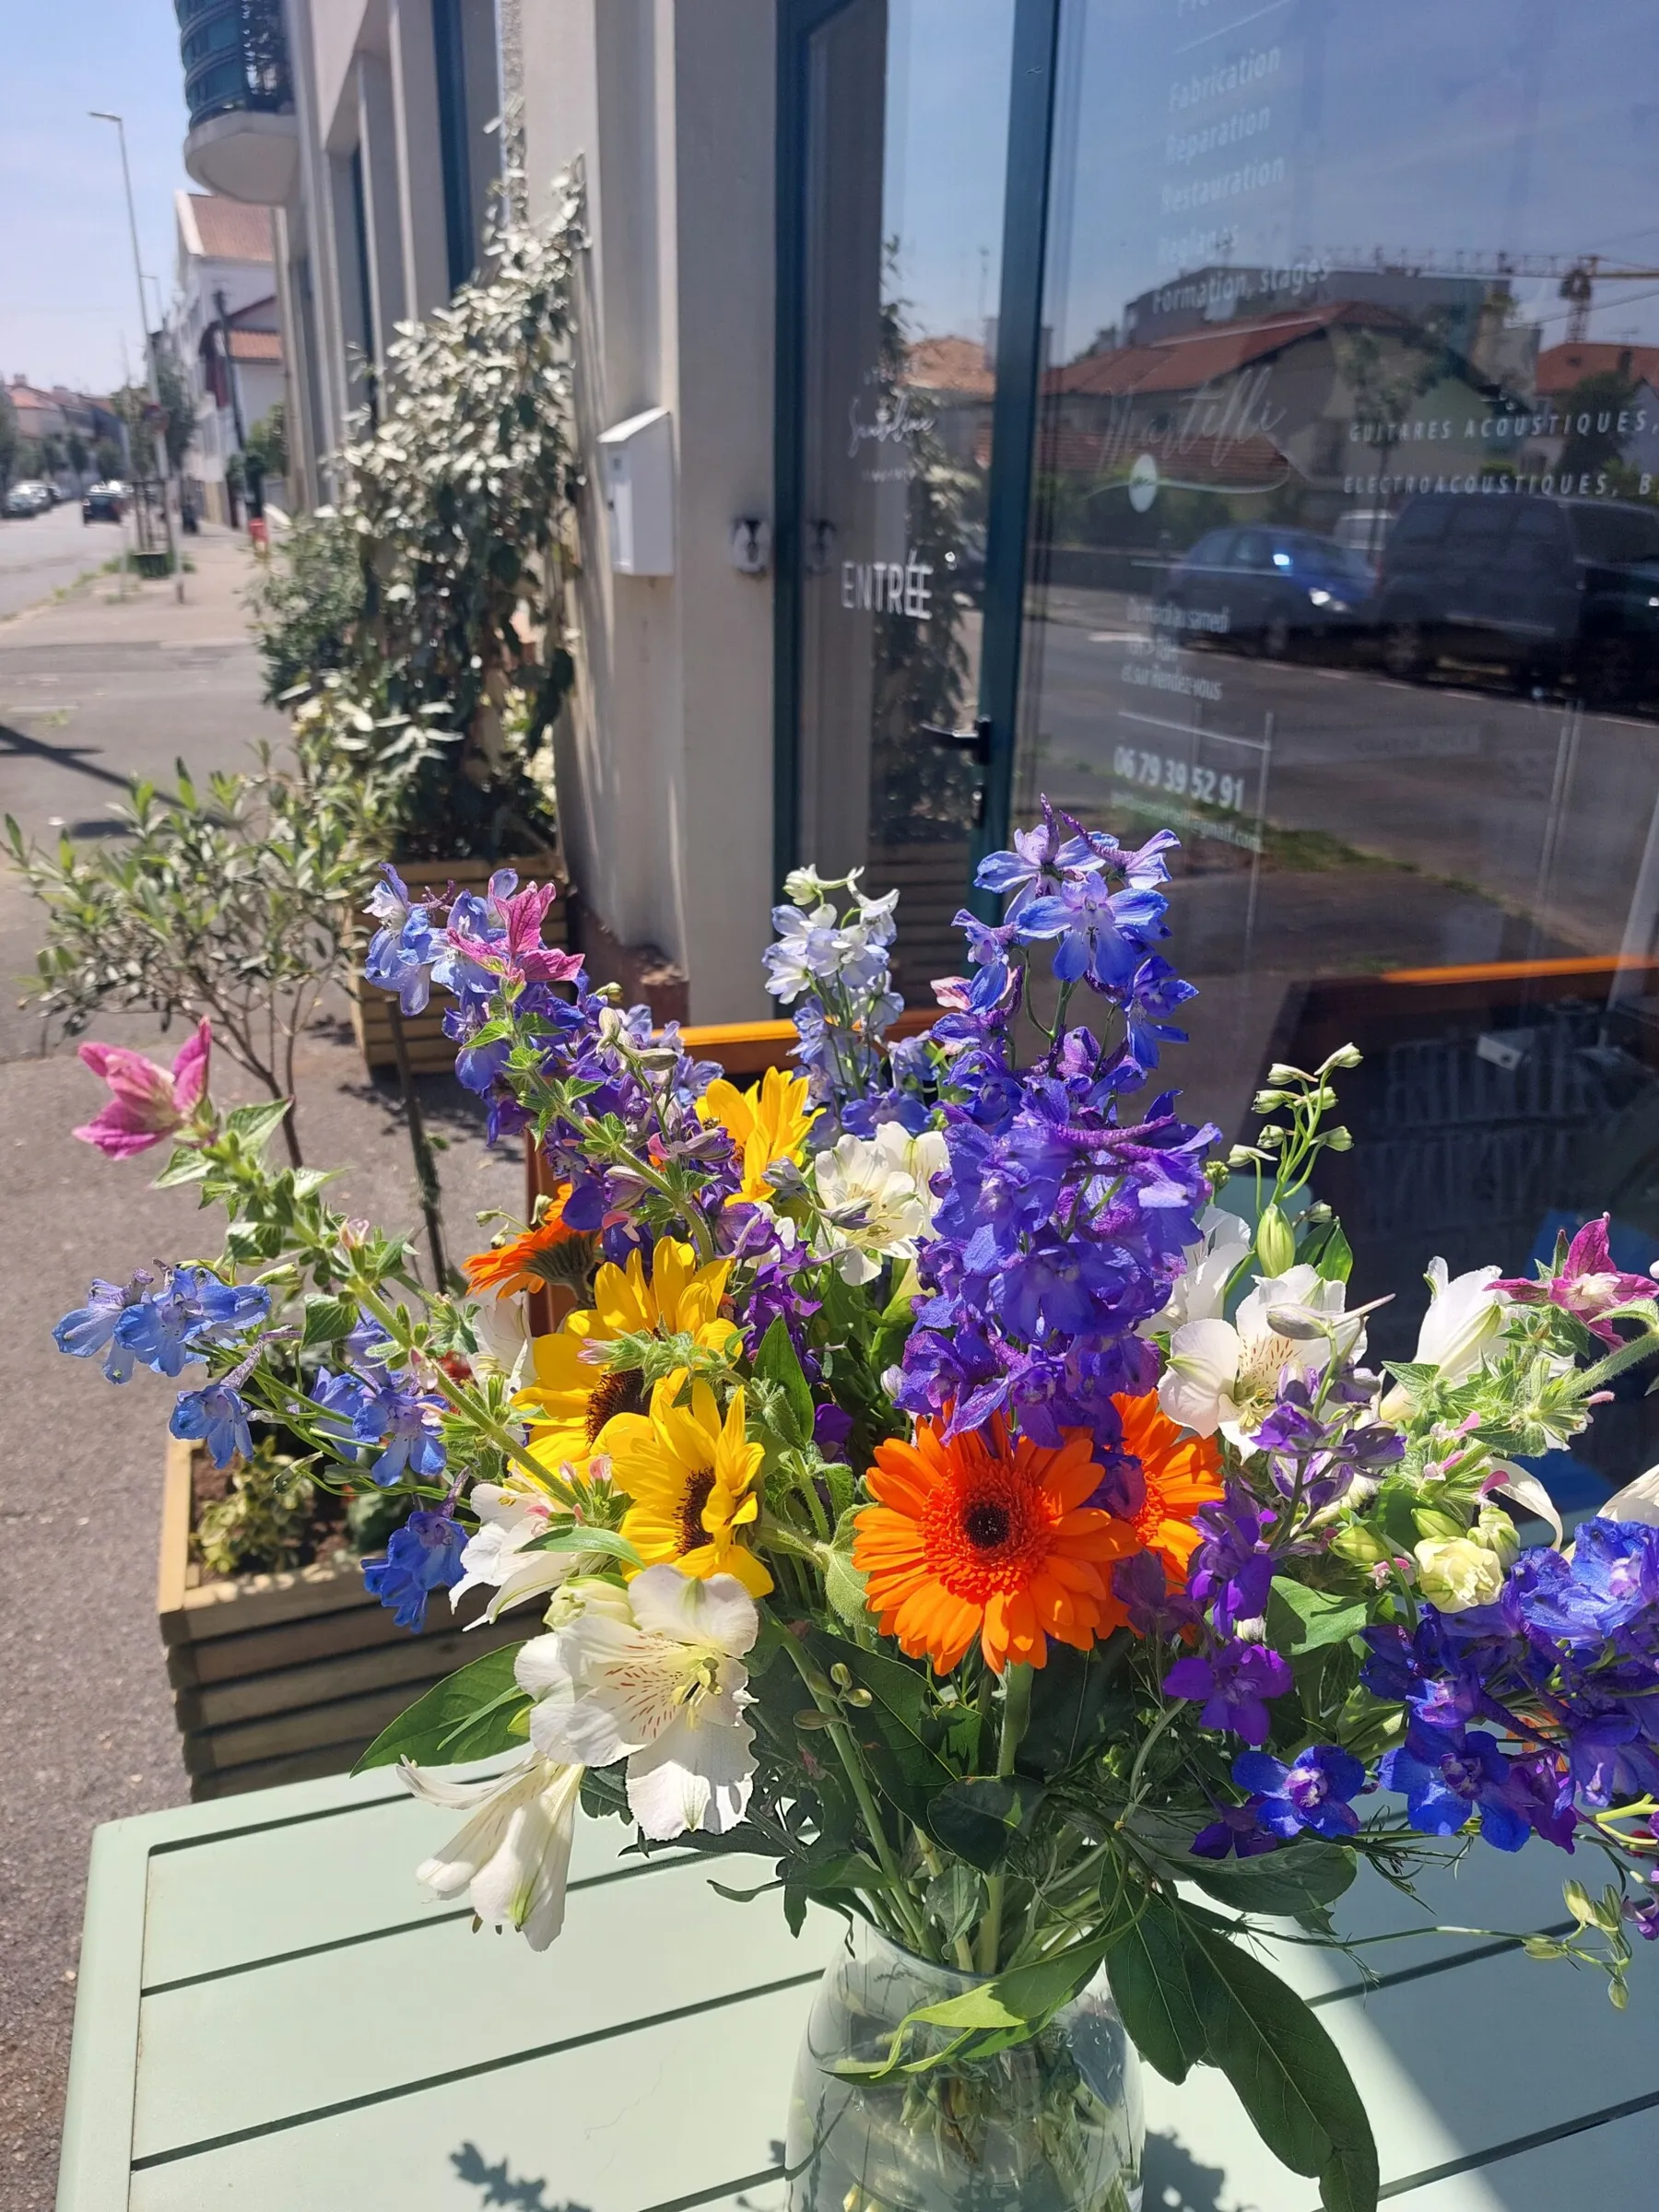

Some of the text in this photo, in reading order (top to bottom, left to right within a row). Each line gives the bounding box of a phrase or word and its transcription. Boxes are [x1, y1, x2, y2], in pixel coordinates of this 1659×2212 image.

[1168, 46, 1282, 113] Fabrication
[1159, 157, 1287, 215] Restauration
[1257, 254, 1332, 296] stages
[1348, 409, 1659, 441] GUITARES ACOUSTIQUES,
[1343, 473, 1618, 497] ELECTROACOUSTIQUES,
[841, 547, 935, 620] ENTRÉE
[1113, 746, 1244, 811] 06 79 39 52 91
